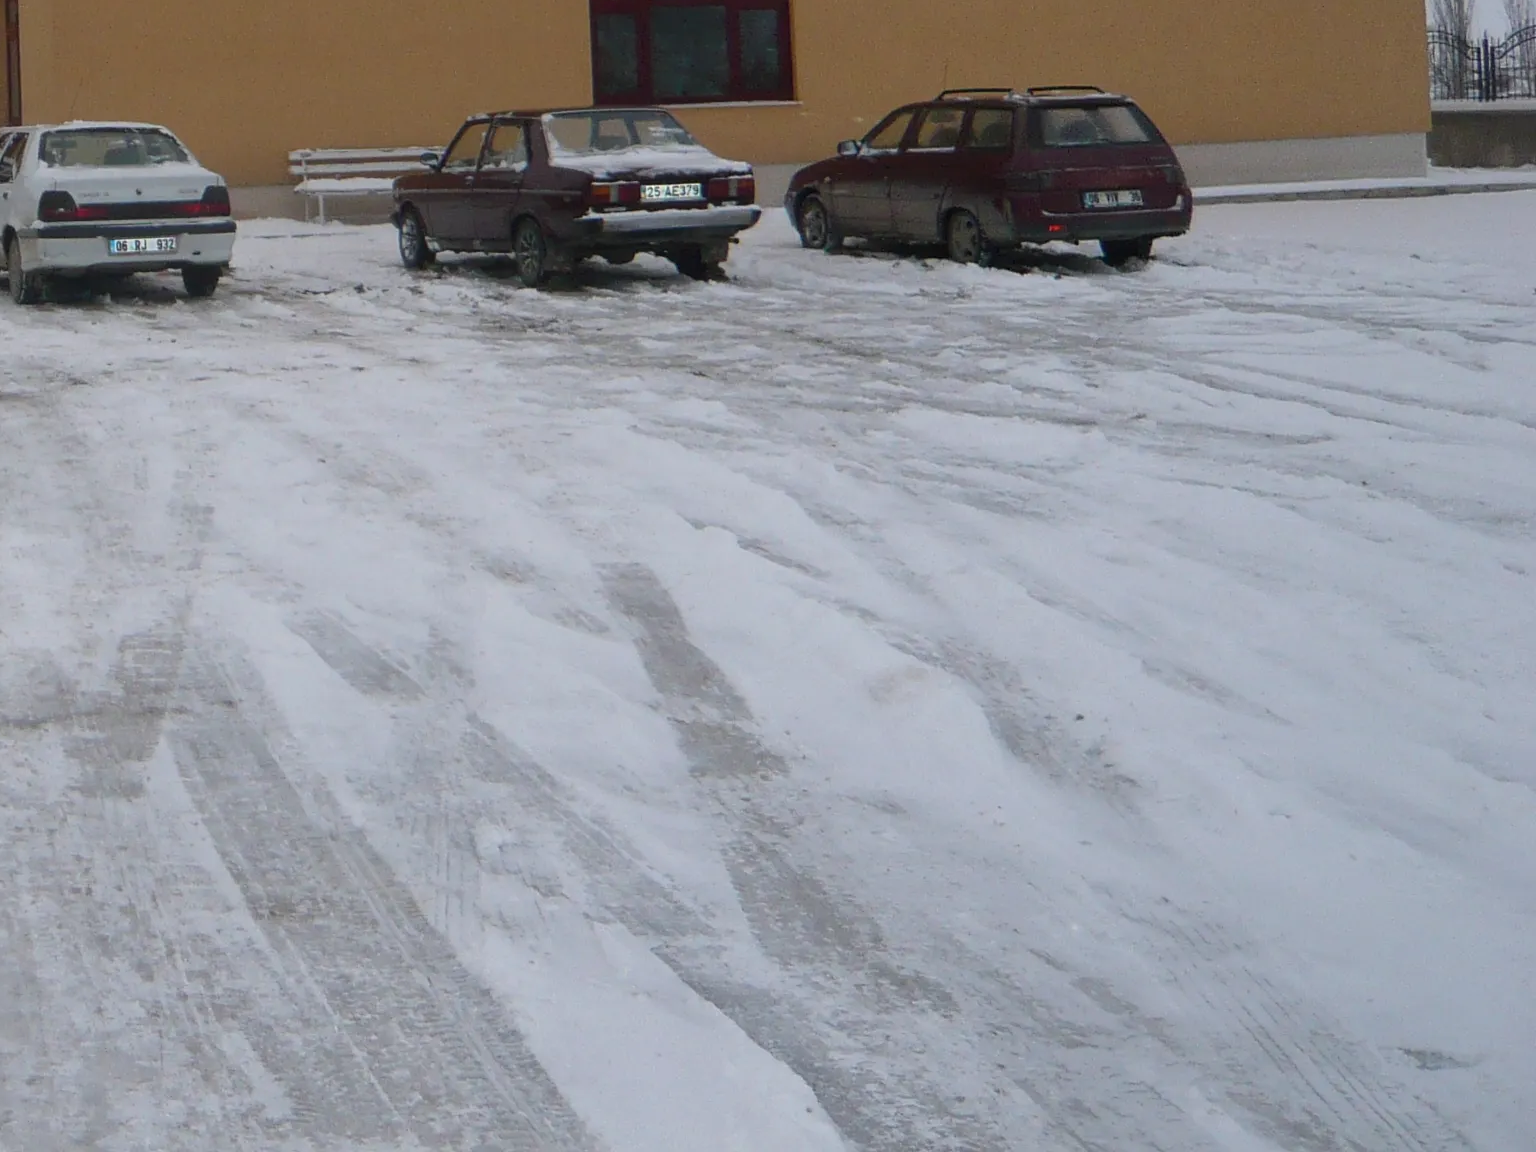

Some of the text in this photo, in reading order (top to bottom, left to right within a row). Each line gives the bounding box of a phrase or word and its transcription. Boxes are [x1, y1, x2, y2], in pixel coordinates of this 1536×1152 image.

[647, 186, 661, 198] 25
[116, 238, 174, 252] 06 RJ 932
